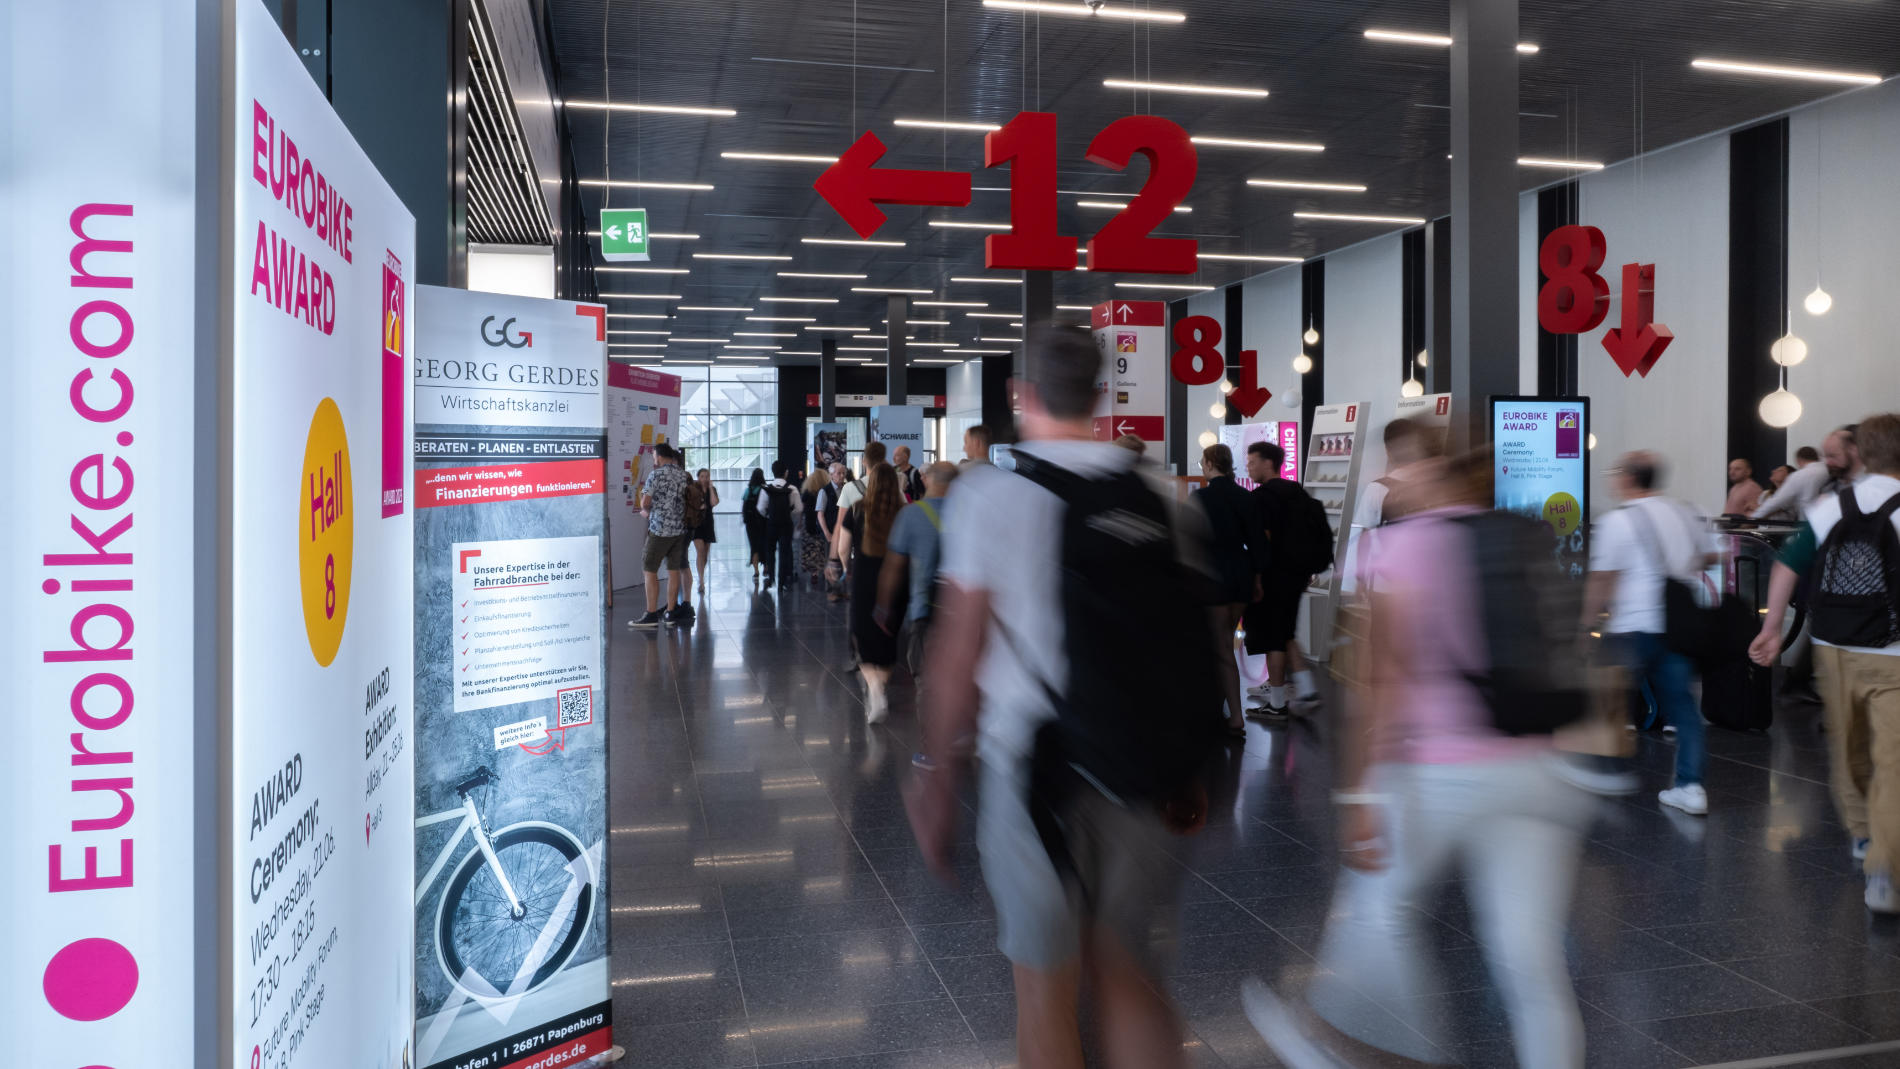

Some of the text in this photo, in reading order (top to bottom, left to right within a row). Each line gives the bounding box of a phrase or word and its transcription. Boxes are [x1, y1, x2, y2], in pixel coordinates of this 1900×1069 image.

[253, 97, 352, 265] EUROBIKE
[985, 112, 1198, 275] 12
[251, 220, 336, 336] AWARD
[1539, 225, 1609, 334] 8
[1117, 358, 1128, 374] 9
[1171, 315, 1224, 385] 8
[508, 364, 599, 387] GERDES
[441, 394, 569, 413] Wirtschaftskanzlei
[1503, 412, 1548, 420] EUROBIKE
[1503, 422, 1538, 431] AWARD
[414, 442, 469, 453] BERATEN
[478, 443, 524, 454] PLANEN
[533, 443, 594, 454] ENTLASTEN
[1284, 428, 1295, 472] CHINA
[310, 450, 343, 542] Hall
[436, 484, 532, 500] Finanzierungen
[459, 472, 473, 480] wir
[475, 470, 506, 480] wissen,
[507, 469, 522, 477] wie
[1549, 501, 1572, 515] Hall
[1559, 517, 1566, 529] 8
[42, 202, 134, 893] Eurobike.com
[474, 566, 504, 575] Unsere
[506, 563, 546, 573] Expertise
[557, 561, 570, 569] der
[325, 553, 336, 621] 8
[474, 574, 549, 587] Fahrradbranche
[565, 572, 580, 580] der:
[365, 666, 390, 715] AWARD
[474, 677, 498, 686] unserer
[499, 673, 528, 683] Expertise
[529, 667, 567, 678] unterstützen
[476, 683, 530, 696] Bankfinanzierung
[530, 679, 553, 689] optimal
[366, 704, 397, 760] Exhibition:
[500, 726, 523, 736] weitere
[500, 735, 519, 745] gleich
[250, 753, 303, 842] AWARD
[251, 798, 319, 904] Ceremony:
[251, 826, 336, 966] Wednesday, 21.06.
[251, 955, 280, 1029] 17:30
[292, 900, 315, 962] 18:15
[263, 1011, 289, 1069] Future
[291, 960, 317, 1021] Mobility
[290, 1018, 304, 1062] Pink
[306, 984, 325, 1029] Stage
[492, 1052, 497, 1062] 1
[513, 1034, 544, 1054] 26871
[548, 1013, 603, 1040] Papenburg
